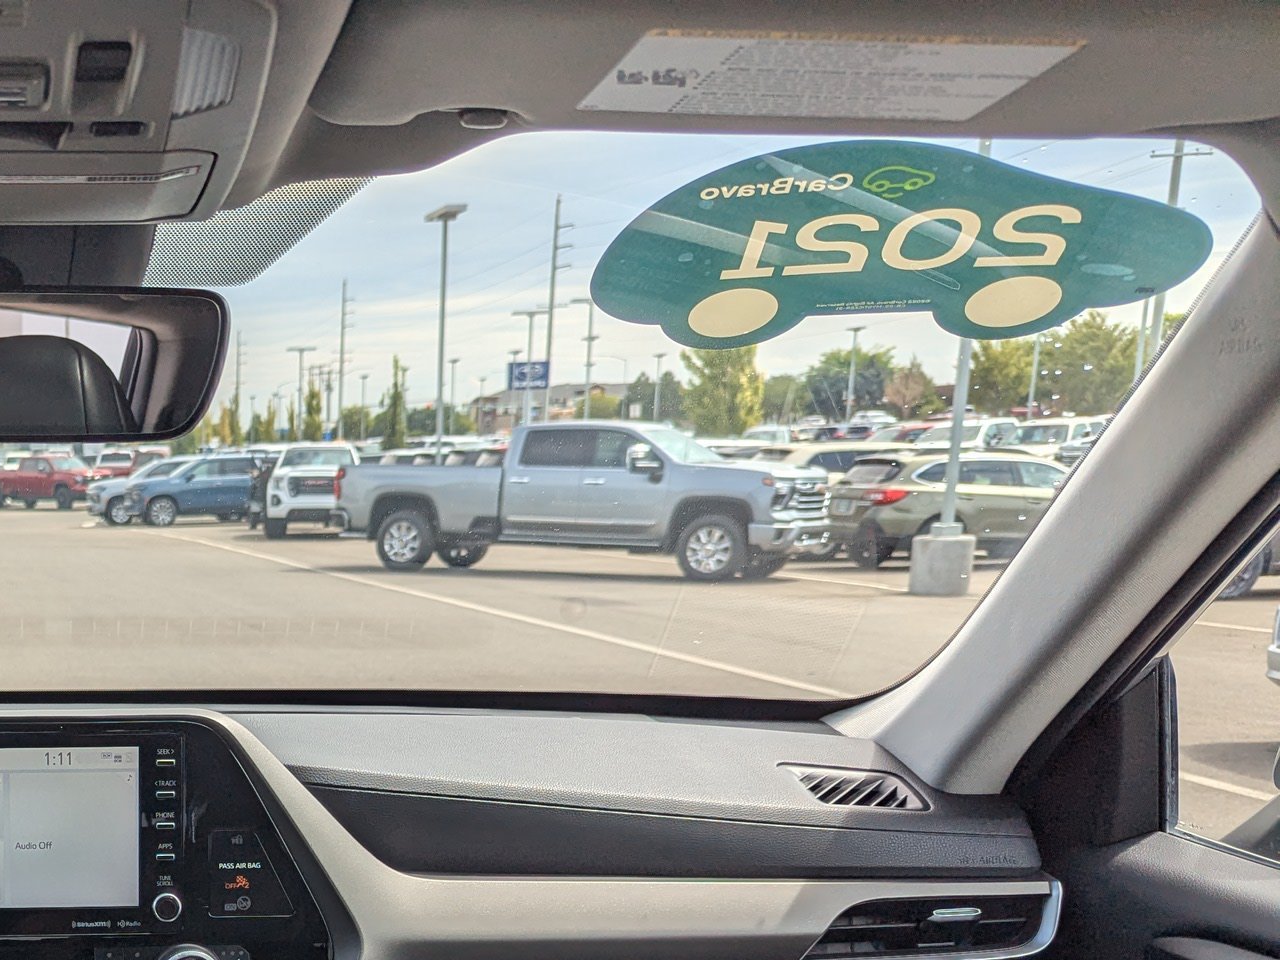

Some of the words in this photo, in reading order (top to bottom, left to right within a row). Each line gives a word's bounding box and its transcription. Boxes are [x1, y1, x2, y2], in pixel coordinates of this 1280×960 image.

[44, 751, 72, 766] 1:11
[15, 841, 37, 850] Audio
[38, 841, 53, 850] Off
